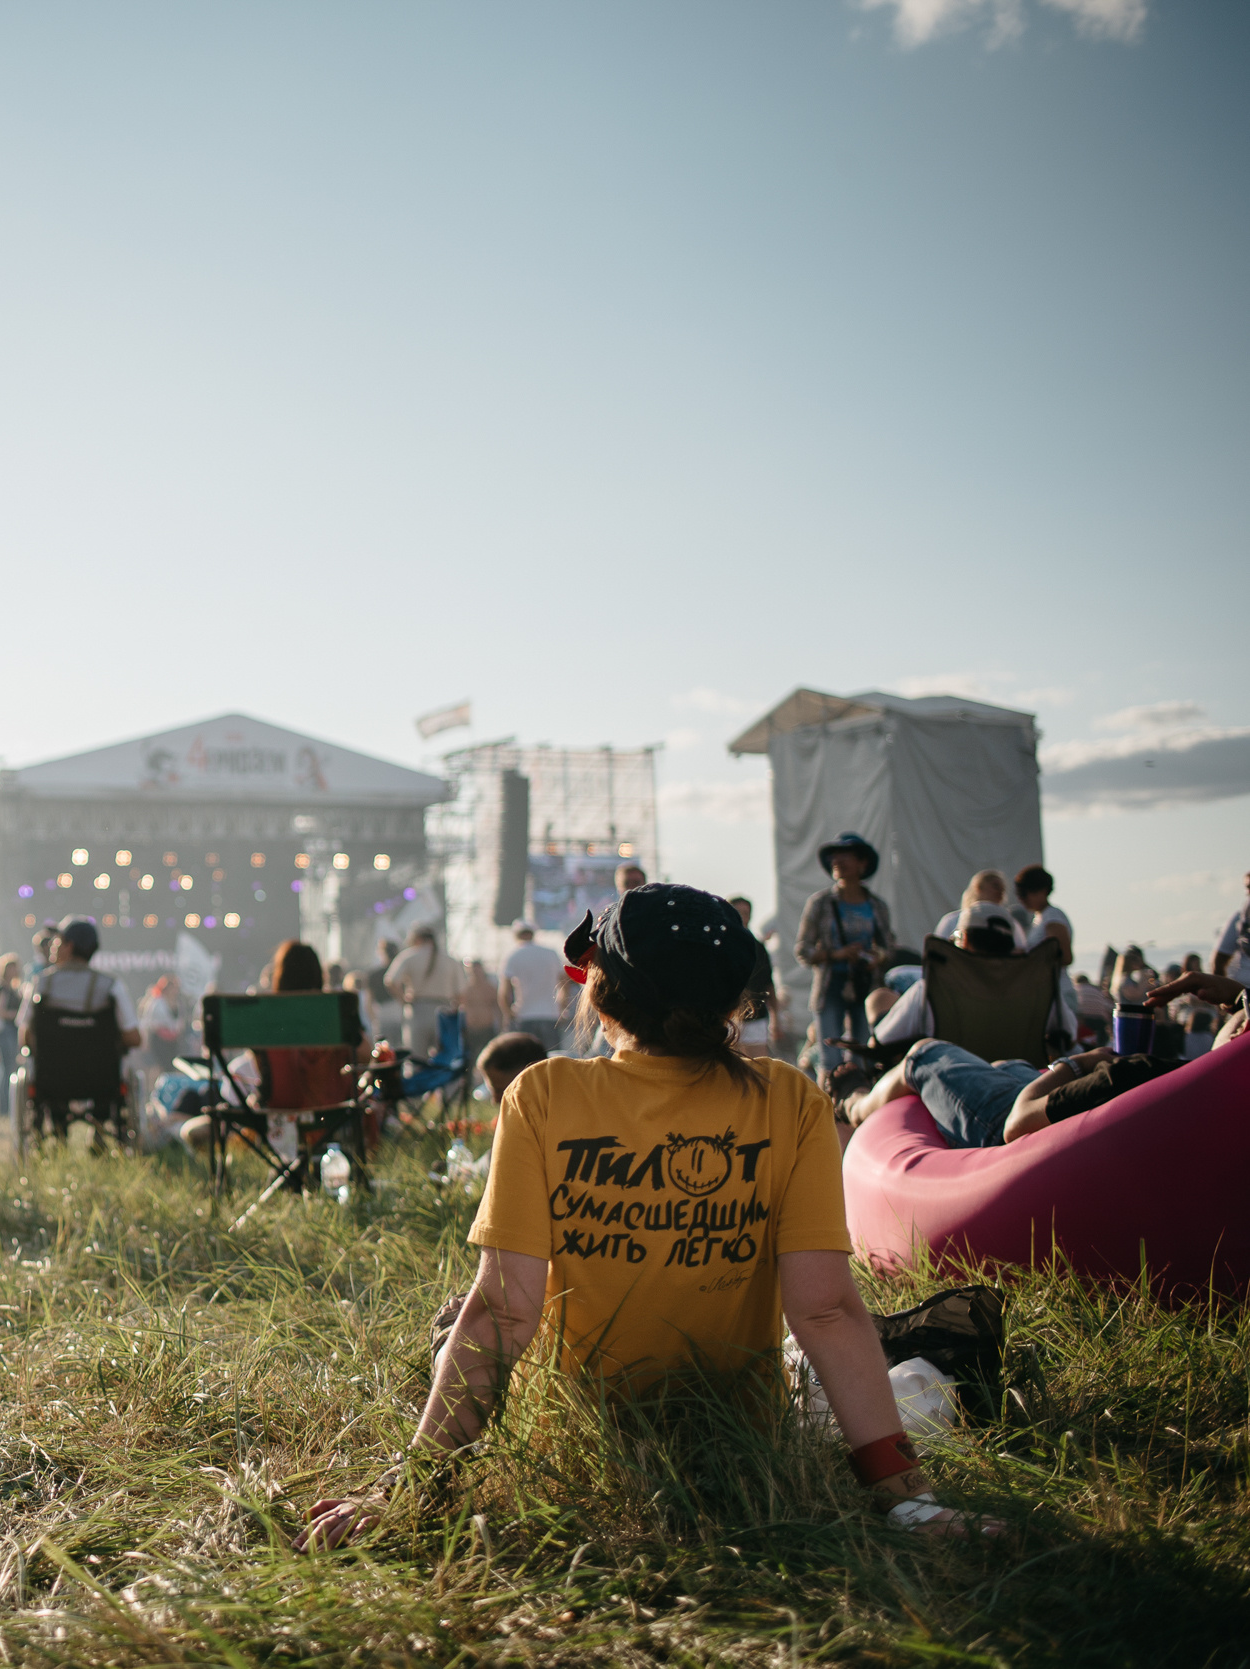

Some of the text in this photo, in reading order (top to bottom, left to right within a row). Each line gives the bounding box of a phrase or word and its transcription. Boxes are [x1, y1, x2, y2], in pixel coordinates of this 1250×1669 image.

[557, 1127, 771, 1197] ПИЛОТ
[550, 1184, 770, 1240] СУМАСШЕДШИМ
[556, 1228, 757, 1268] ЖИТЬ ЛЕГКО
